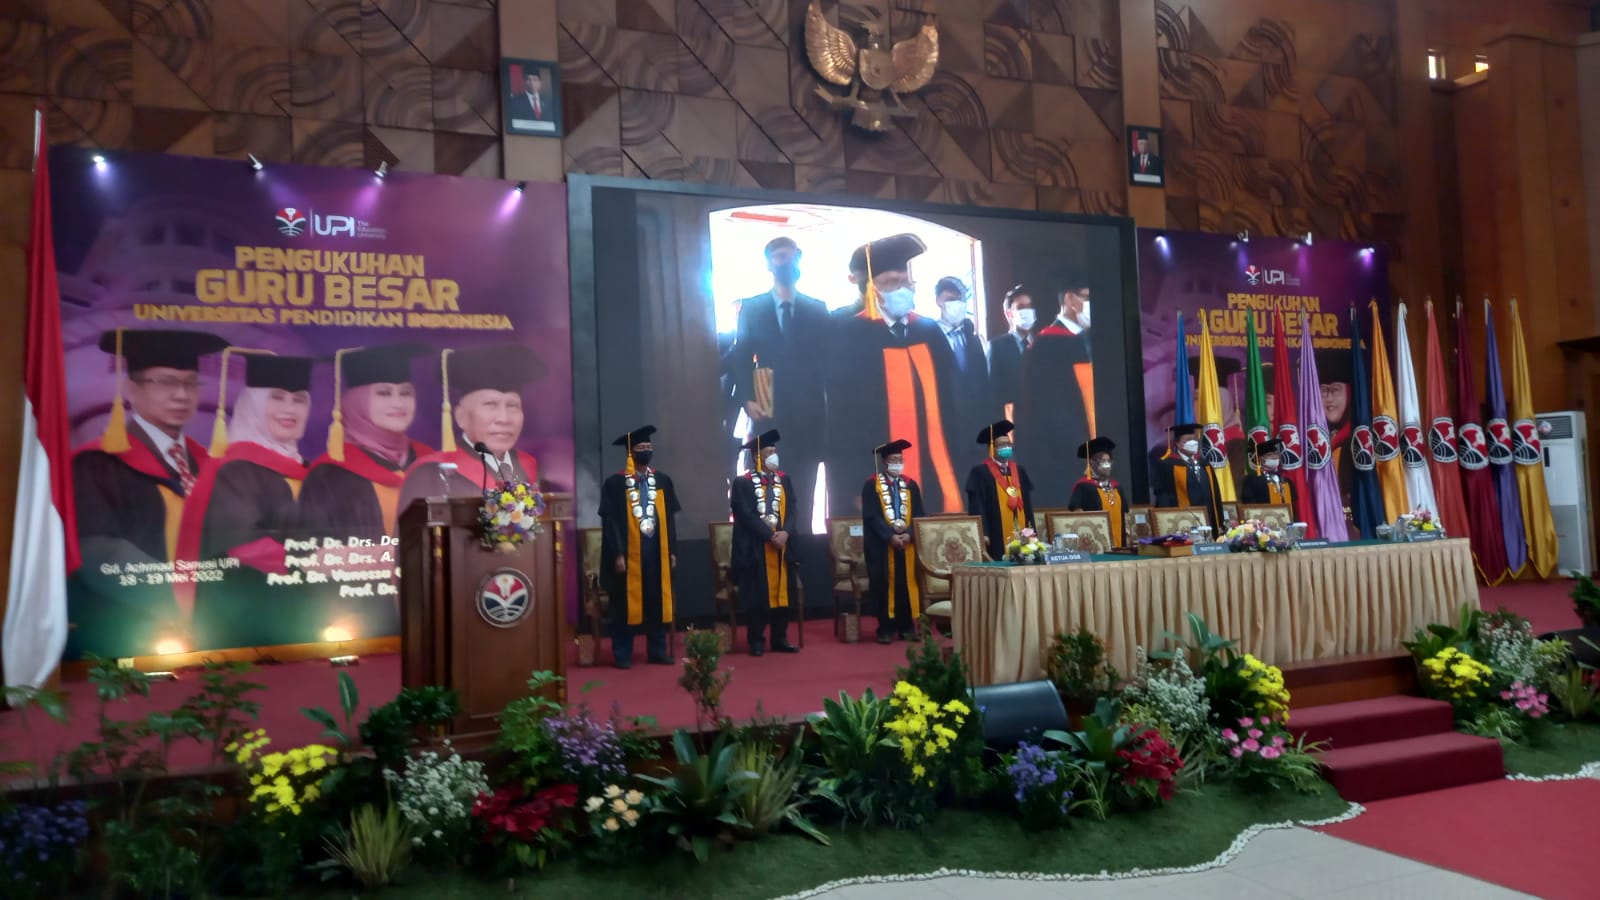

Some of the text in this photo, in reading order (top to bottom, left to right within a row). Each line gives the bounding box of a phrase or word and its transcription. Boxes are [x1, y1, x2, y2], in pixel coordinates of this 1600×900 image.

[314, 214, 355, 237] UPI
[234, 246, 425, 277] PENGUKUHAN
[195, 268, 461, 312] GURU BESAR
[133, 303, 514, 330] UNIVERSITAS PENDIDIKAN INDONESIA
[284, 537, 319, 551] Prof.
[348, 536, 376, 548] Drs.
[284, 554, 320, 568] Prof.
[348, 552, 377, 564] Drs.
[380, 551, 395, 562] A.
